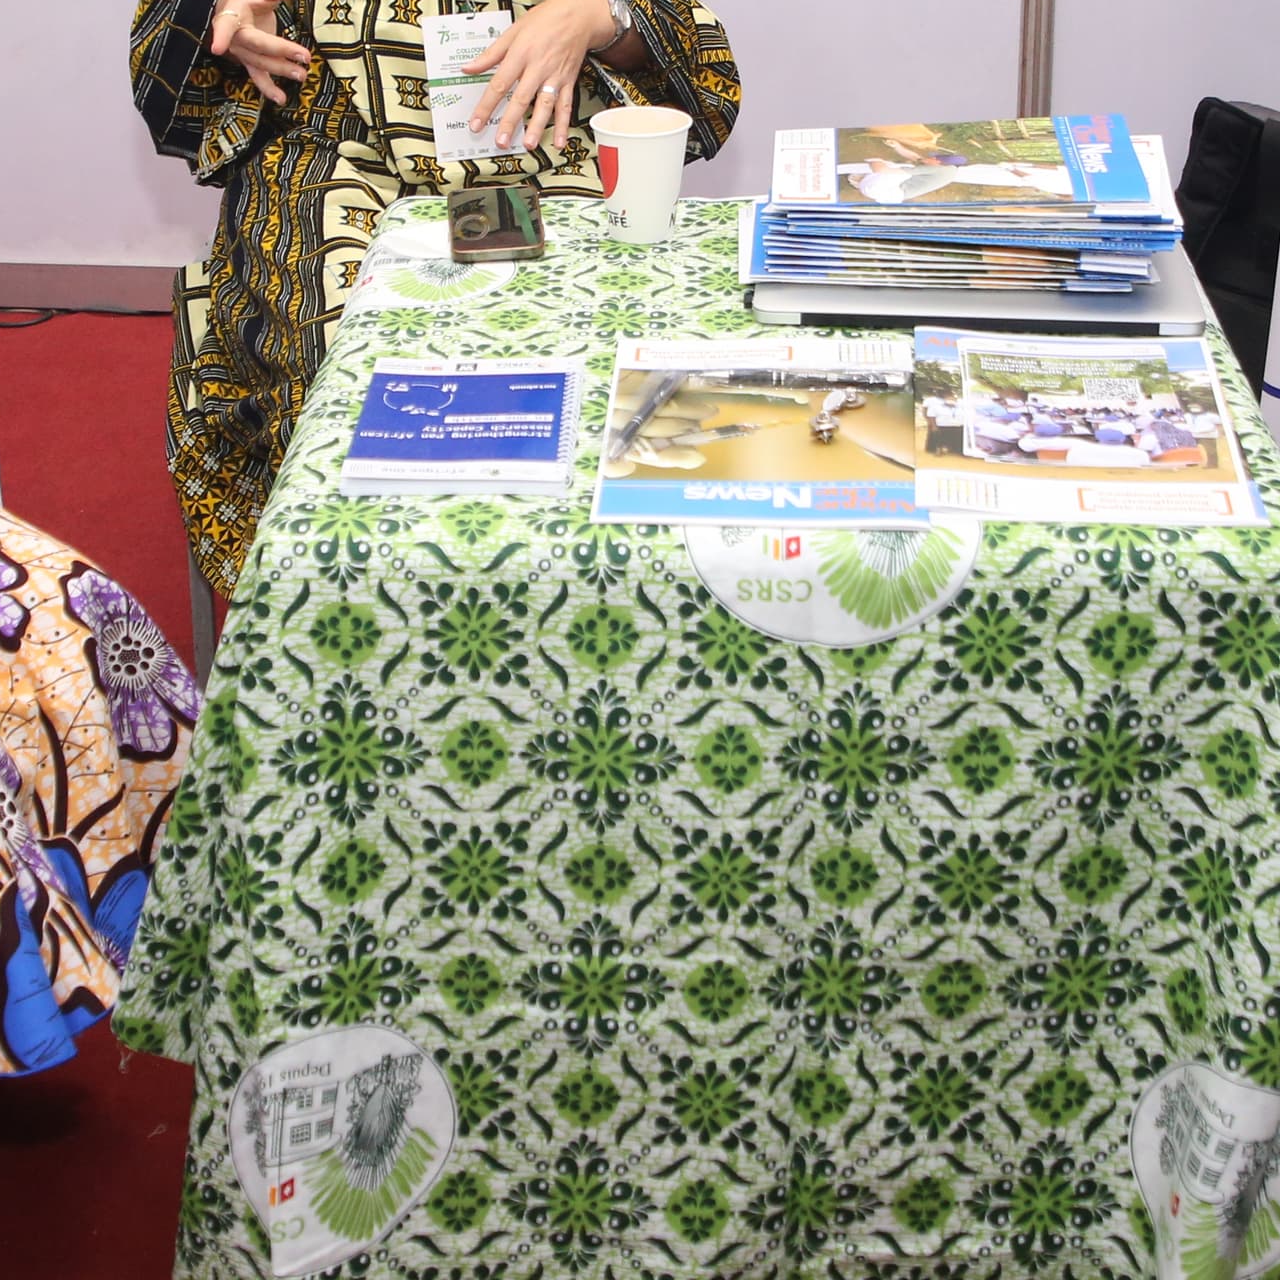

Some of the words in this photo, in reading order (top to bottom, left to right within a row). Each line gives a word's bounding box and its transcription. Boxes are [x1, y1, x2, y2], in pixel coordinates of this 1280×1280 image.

[1077, 143, 1113, 173] News
[683, 484, 813, 510] News
[736, 579, 813, 603] CSRS
[279, 1063, 331, 1082] Depuis
